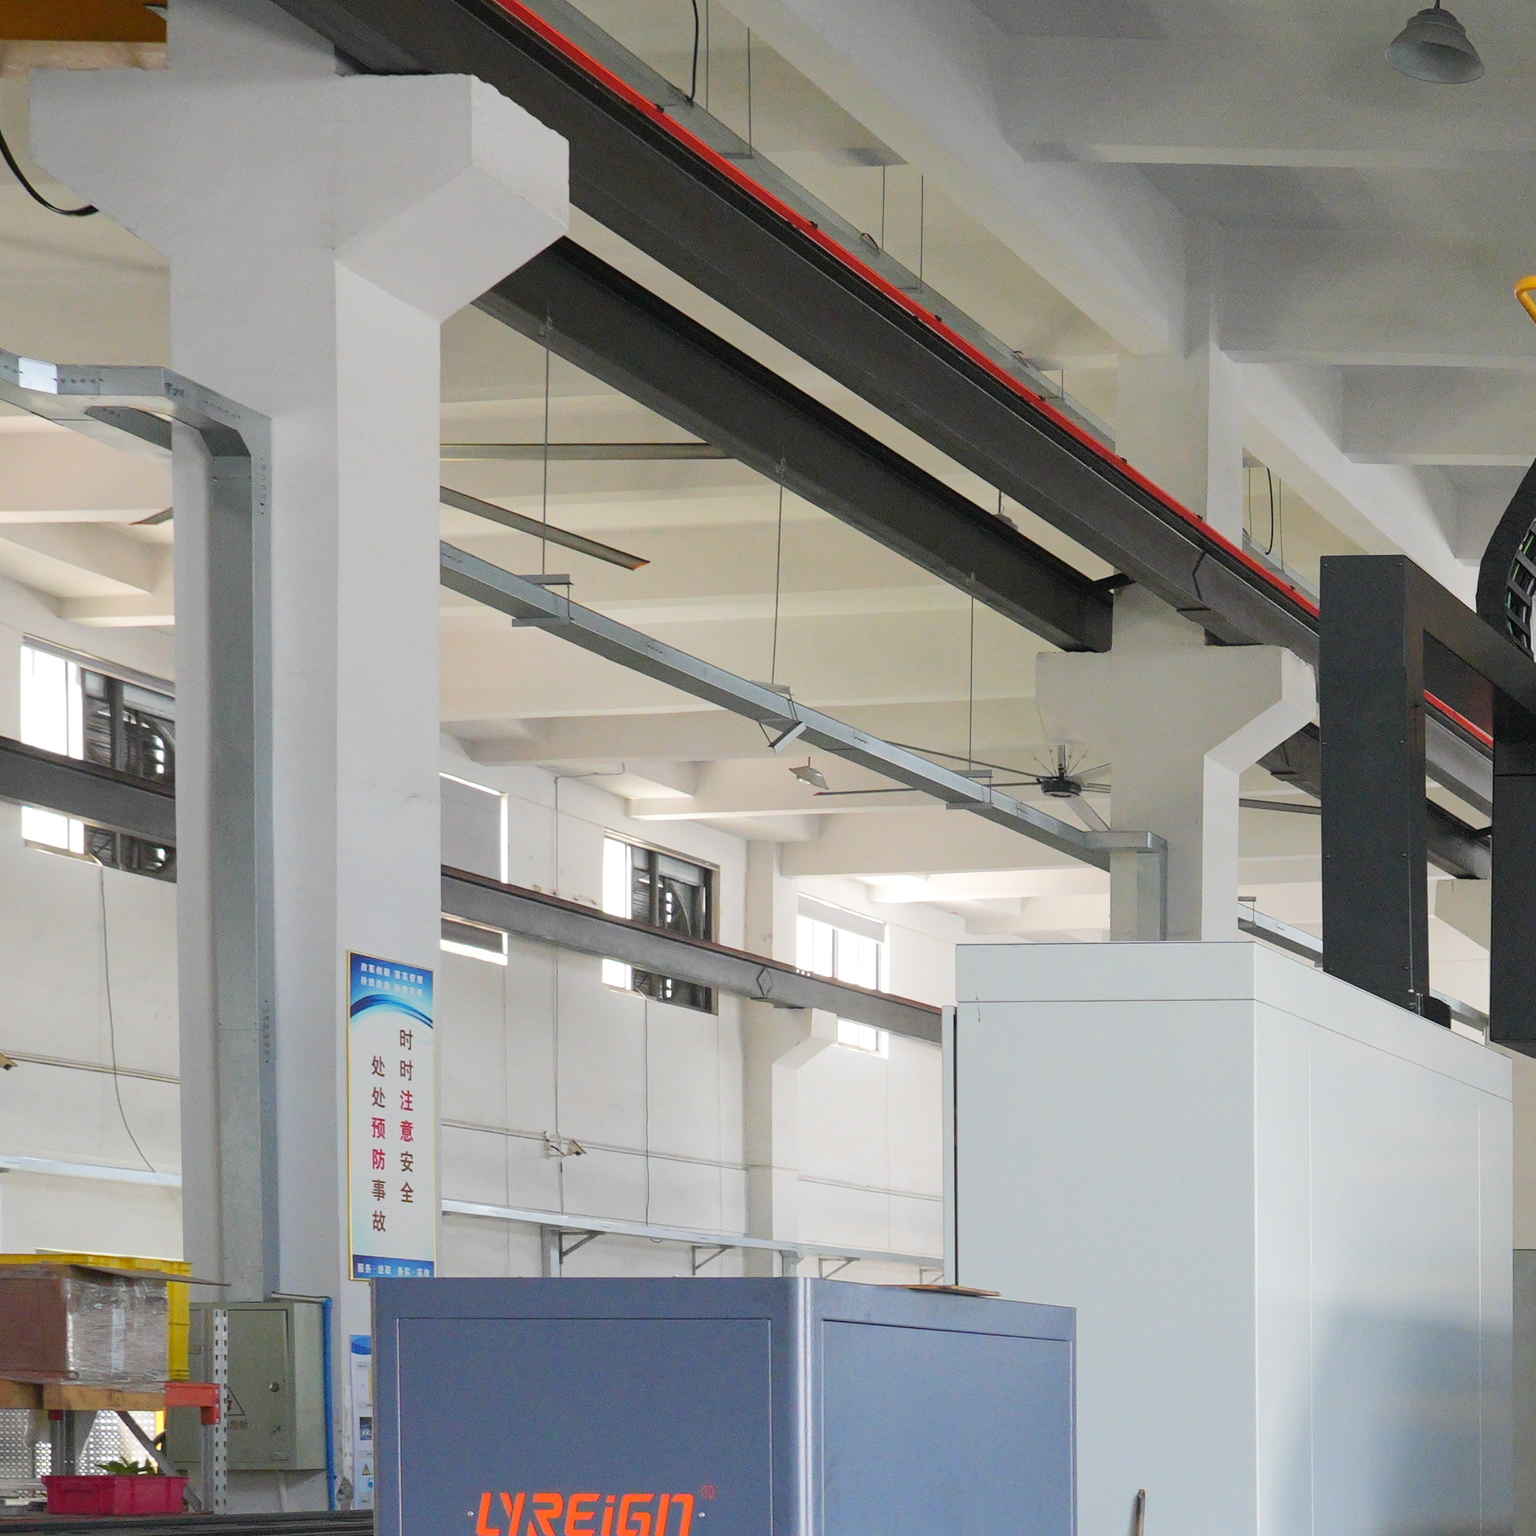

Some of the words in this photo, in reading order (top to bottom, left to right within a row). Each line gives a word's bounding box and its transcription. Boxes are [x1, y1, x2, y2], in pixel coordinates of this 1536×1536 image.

[371, 1056, 386, 1232] 处处预防事故
[399, 1029, 414, 1203] 时时注意安全
